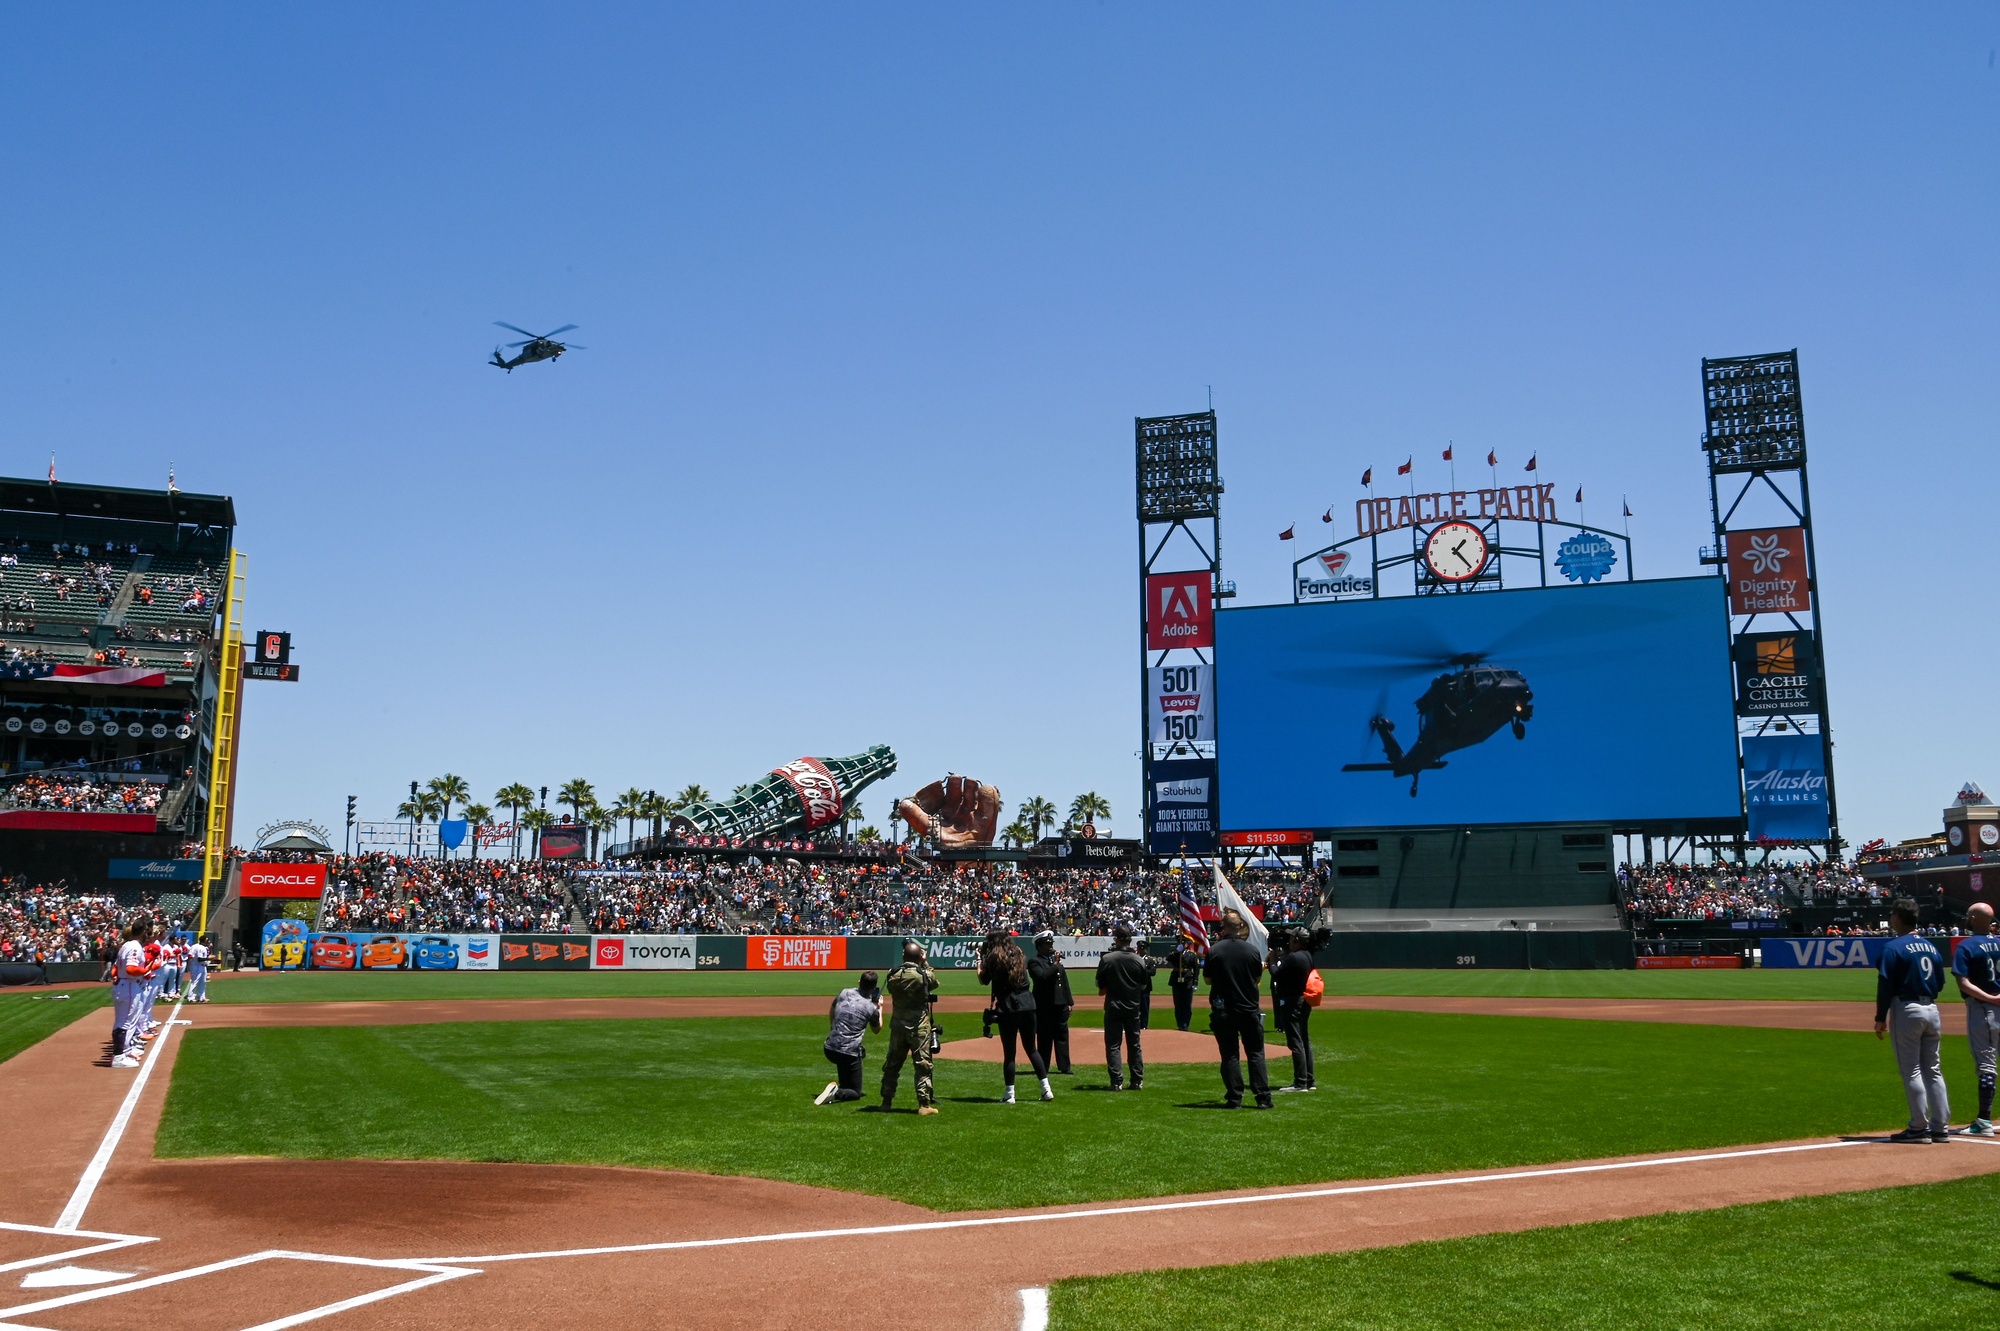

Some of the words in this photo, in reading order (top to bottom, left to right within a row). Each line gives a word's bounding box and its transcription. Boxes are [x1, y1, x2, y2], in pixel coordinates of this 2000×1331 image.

[1355, 490, 1468, 538] ORACLE
[1477, 482, 1558, 524] PARK
[1563, 541, 1610, 557] coupa
[1298, 577, 1372, 596] Fanatics
[1740, 577, 1797, 596] Dignity
[1744, 594, 1796, 610] Health
[1162, 622, 1198, 637] Adobe
[265, 635, 281, 659] G
[252, 666, 264, 676] WE
[264, 666, 279, 677] ARE
[1163, 666, 1197, 693] 501
[1747, 675, 1808, 689] CACHE
[1749, 687, 1807, 701] CREEK
[1748, 702, 1778, 710] CASINO
[1746, 769, 1824, 791] Alaska
[1162, 786, 1202, 796] StubHub
[1752, 793, 1818, 803] AIRLINES
[1957, 790, 1985, 800] Coors
[1158, 809, 1177, 820] 100%
[1178, 808, 1208, 820] VERIFIED
[358, 817, 434, 845] blue
[1156, 821, 1181, 833] GIANTS
[1182, 821, 1211, 832] TICKETS
[1246, 833, 1287, 844] $11,530
[1756, 833, 1794, 847] Coors
[1794, 837, 1825, 845] LIGHT
[1085, 844, 1103, 857] Peet's
[1103, 845, 1124, 858] Coffee
[139, 861, 176, 873] Alaska
[249, 874, 316, 885] ORACLE
[629, 946, 691, 958] TOYOTA
[783, 939, 832, 953] NOTHING
[929, 941, 976, 958] Natio
[1785, 940, 1870, 966] VISA
[698, 955, 720, 965] 354
[783, 951, 811, 967] LIKE
[814, 950, 831, 967] IT
[1074, 950, 1085, 958] OF
[1456, 955, 1476, 965] 391
[954, 959, 970, 967] Car
[1920, 956, 1933, 980] 9
